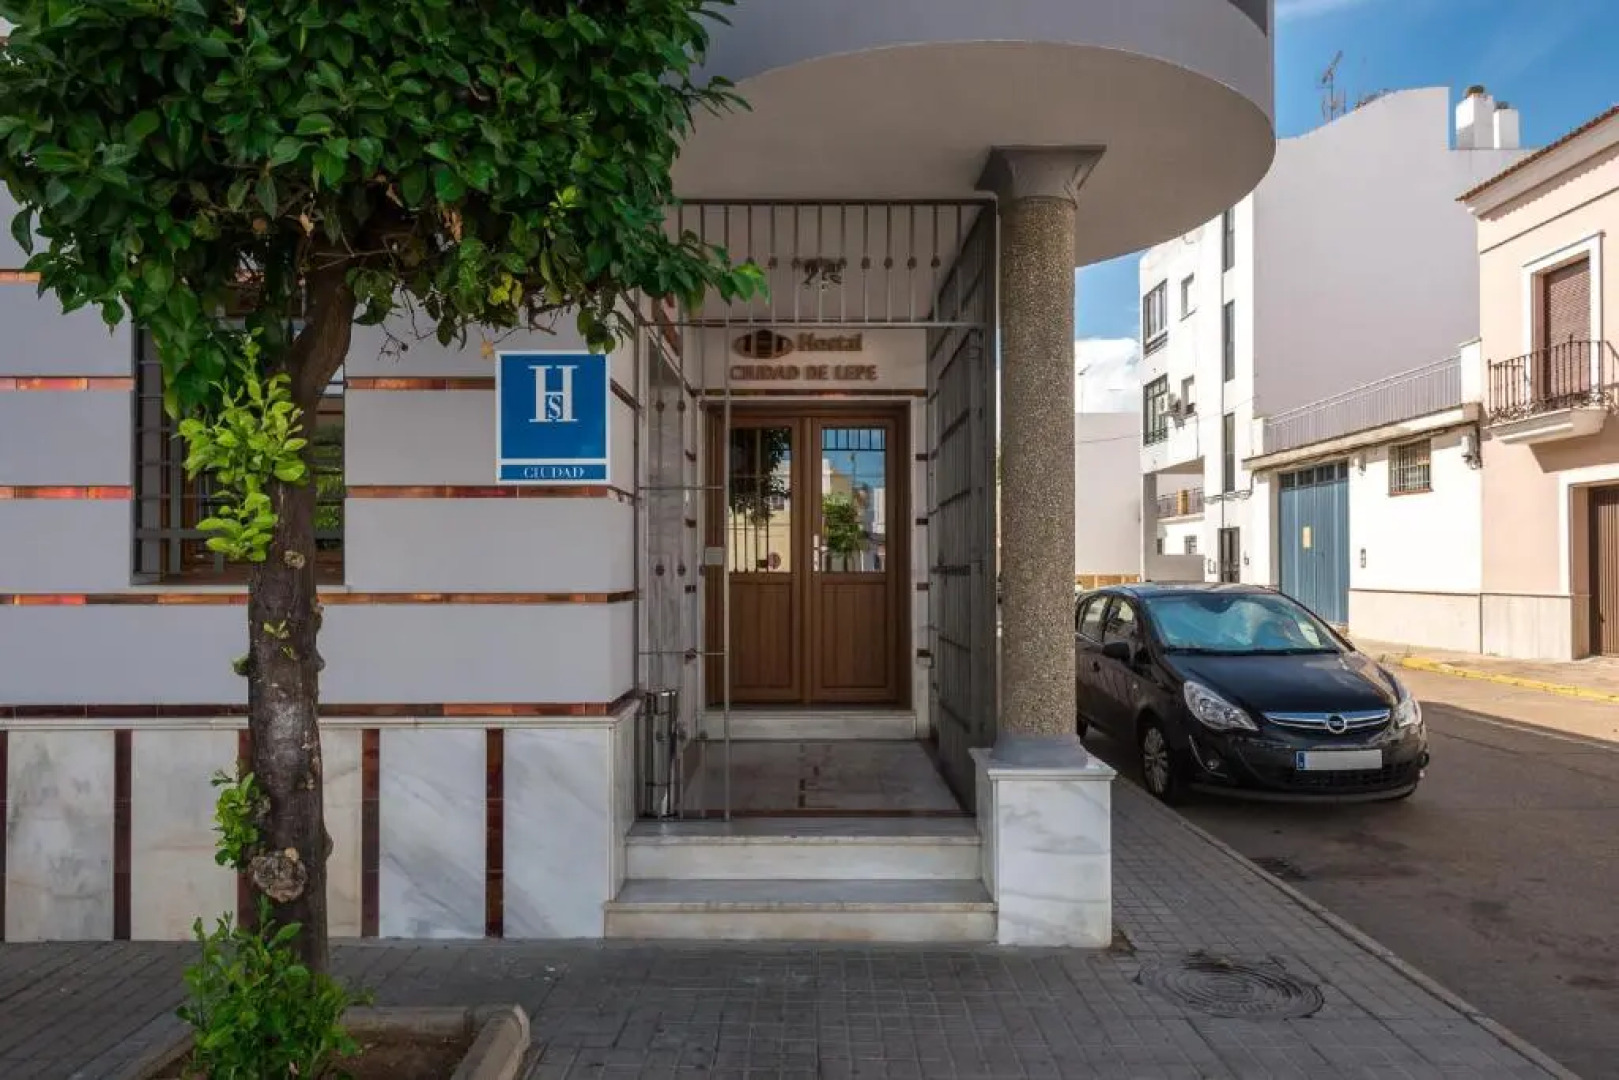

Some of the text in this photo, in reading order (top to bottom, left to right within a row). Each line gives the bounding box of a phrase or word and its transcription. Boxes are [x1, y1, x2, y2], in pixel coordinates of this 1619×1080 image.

[798, 332, 863, 351] Hostal
[730, 364, 878, 381] CIUDAD DE LEPE
[523, 466, 585, 479] CIUDAD
